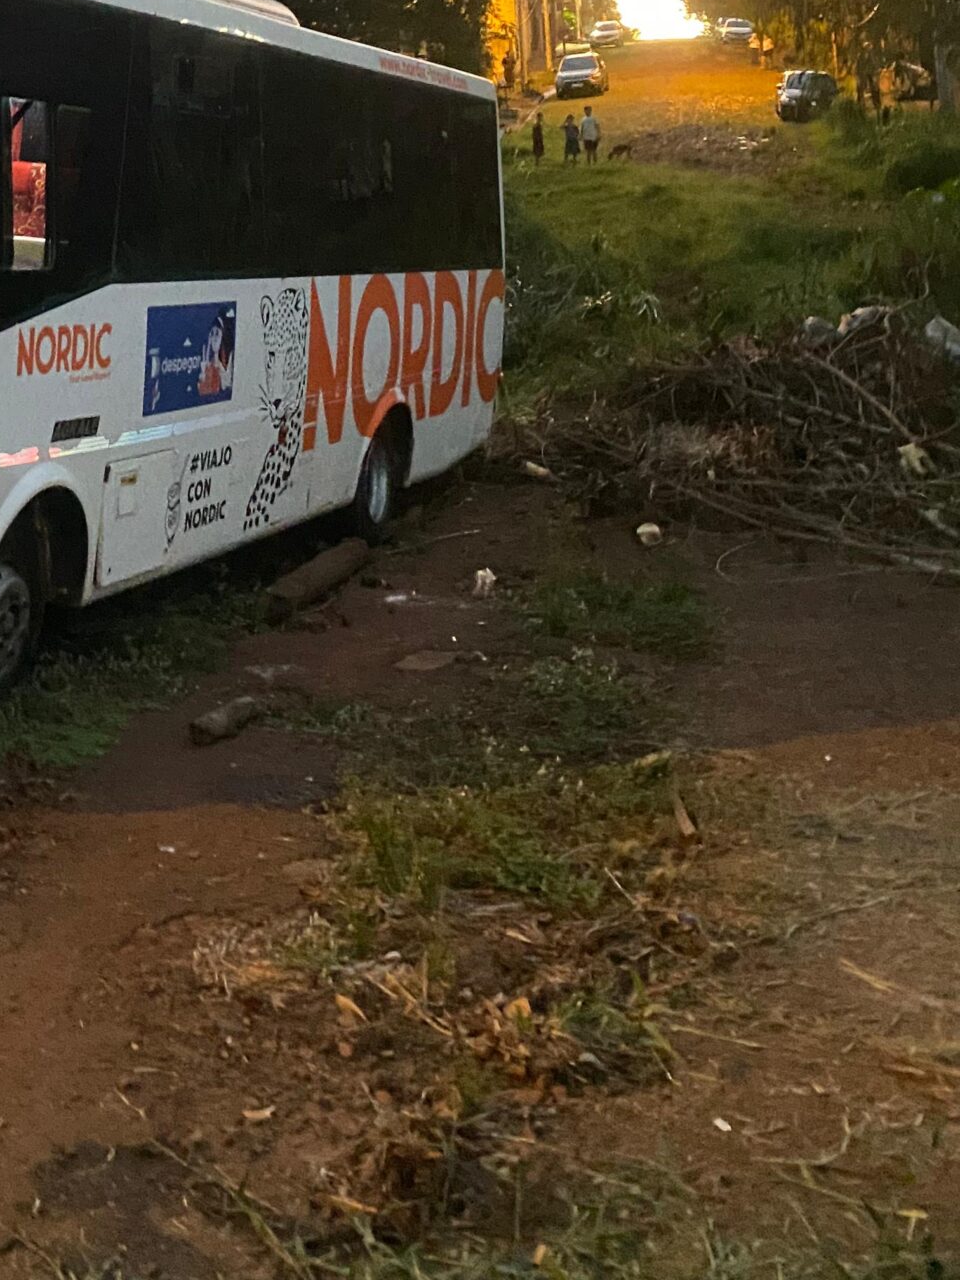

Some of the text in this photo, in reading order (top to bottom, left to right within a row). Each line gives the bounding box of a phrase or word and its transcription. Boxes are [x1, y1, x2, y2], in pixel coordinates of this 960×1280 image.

[16, 322, 113, 377] NORDIC
[302, 269, 506, 452] NORDIC
[161, 355, 201, 376] despegar
[189, 445, 233, 475] #VIAJO
[187, 478, 212, 503] CON
[183, 500, 227, 533] NORDIC
